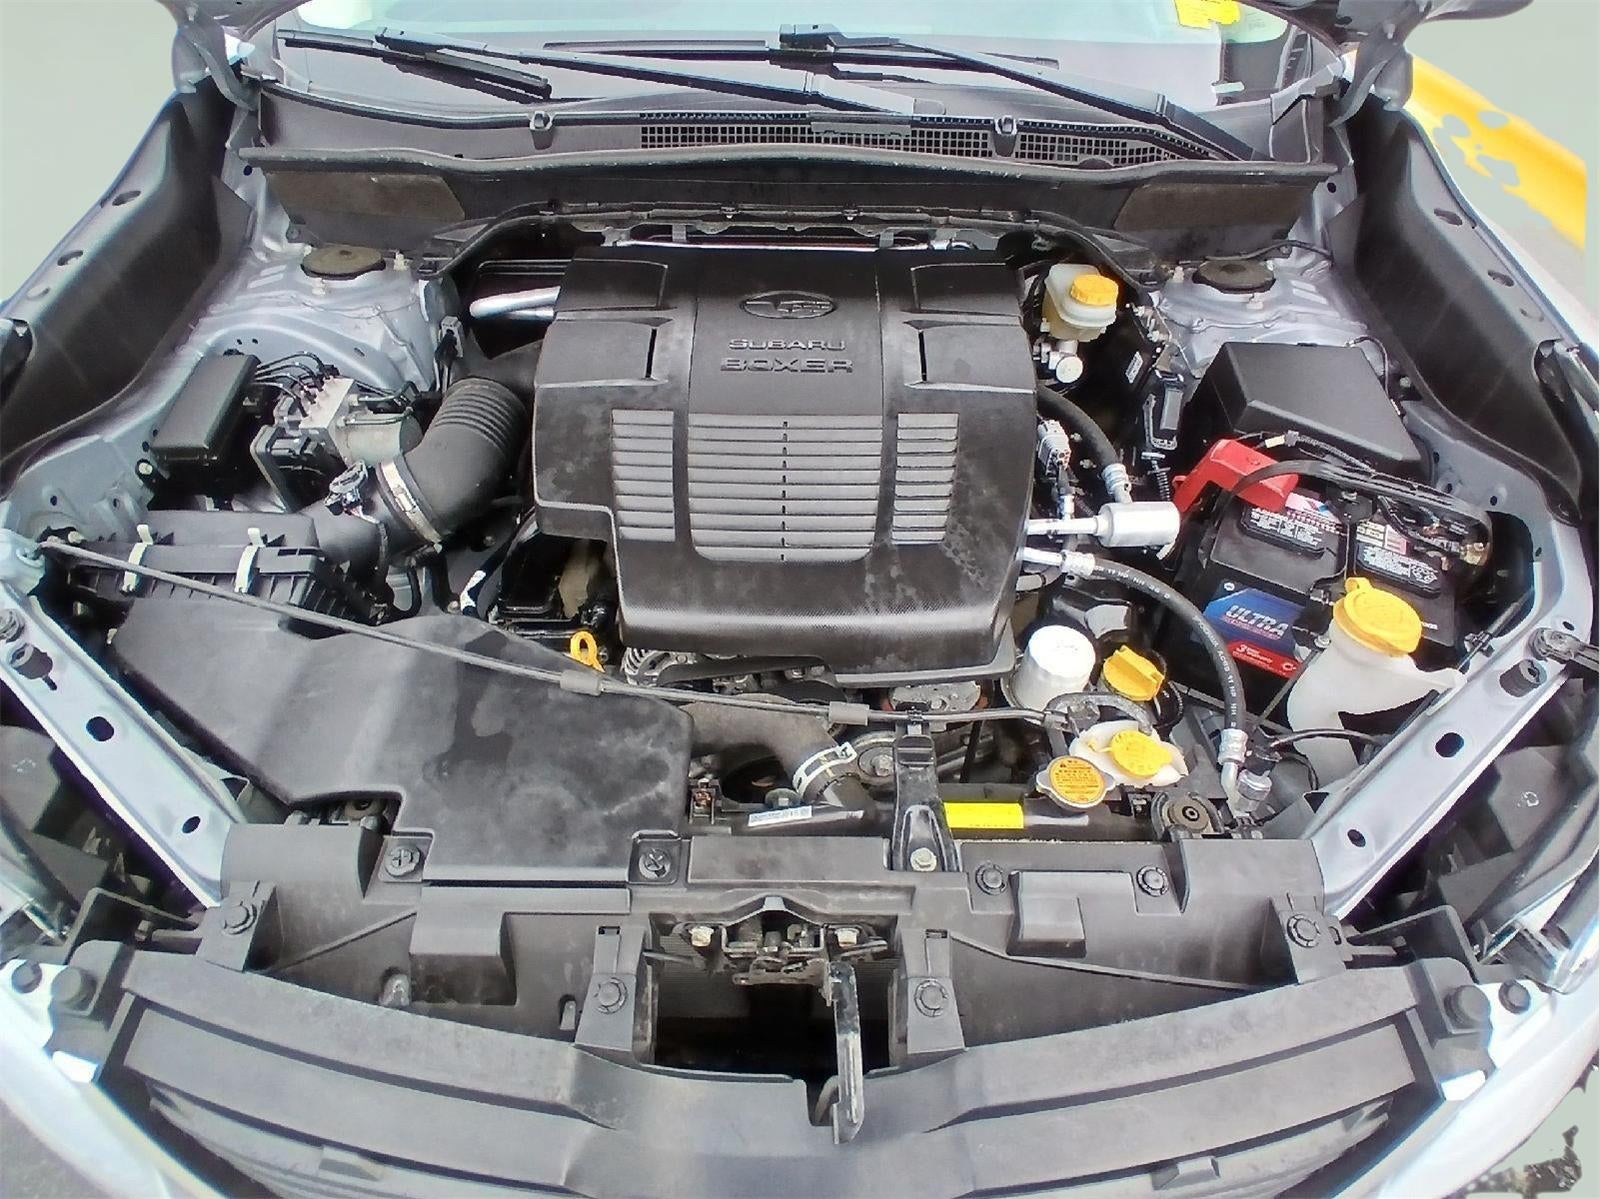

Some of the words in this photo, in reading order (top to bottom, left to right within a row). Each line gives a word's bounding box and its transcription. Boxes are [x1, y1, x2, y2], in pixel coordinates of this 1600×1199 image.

[728, 338, 846, 352] SUBARU
[719, 358, 853, 374] BOXER
[1225, 604, 1290, 638] ULTRA
